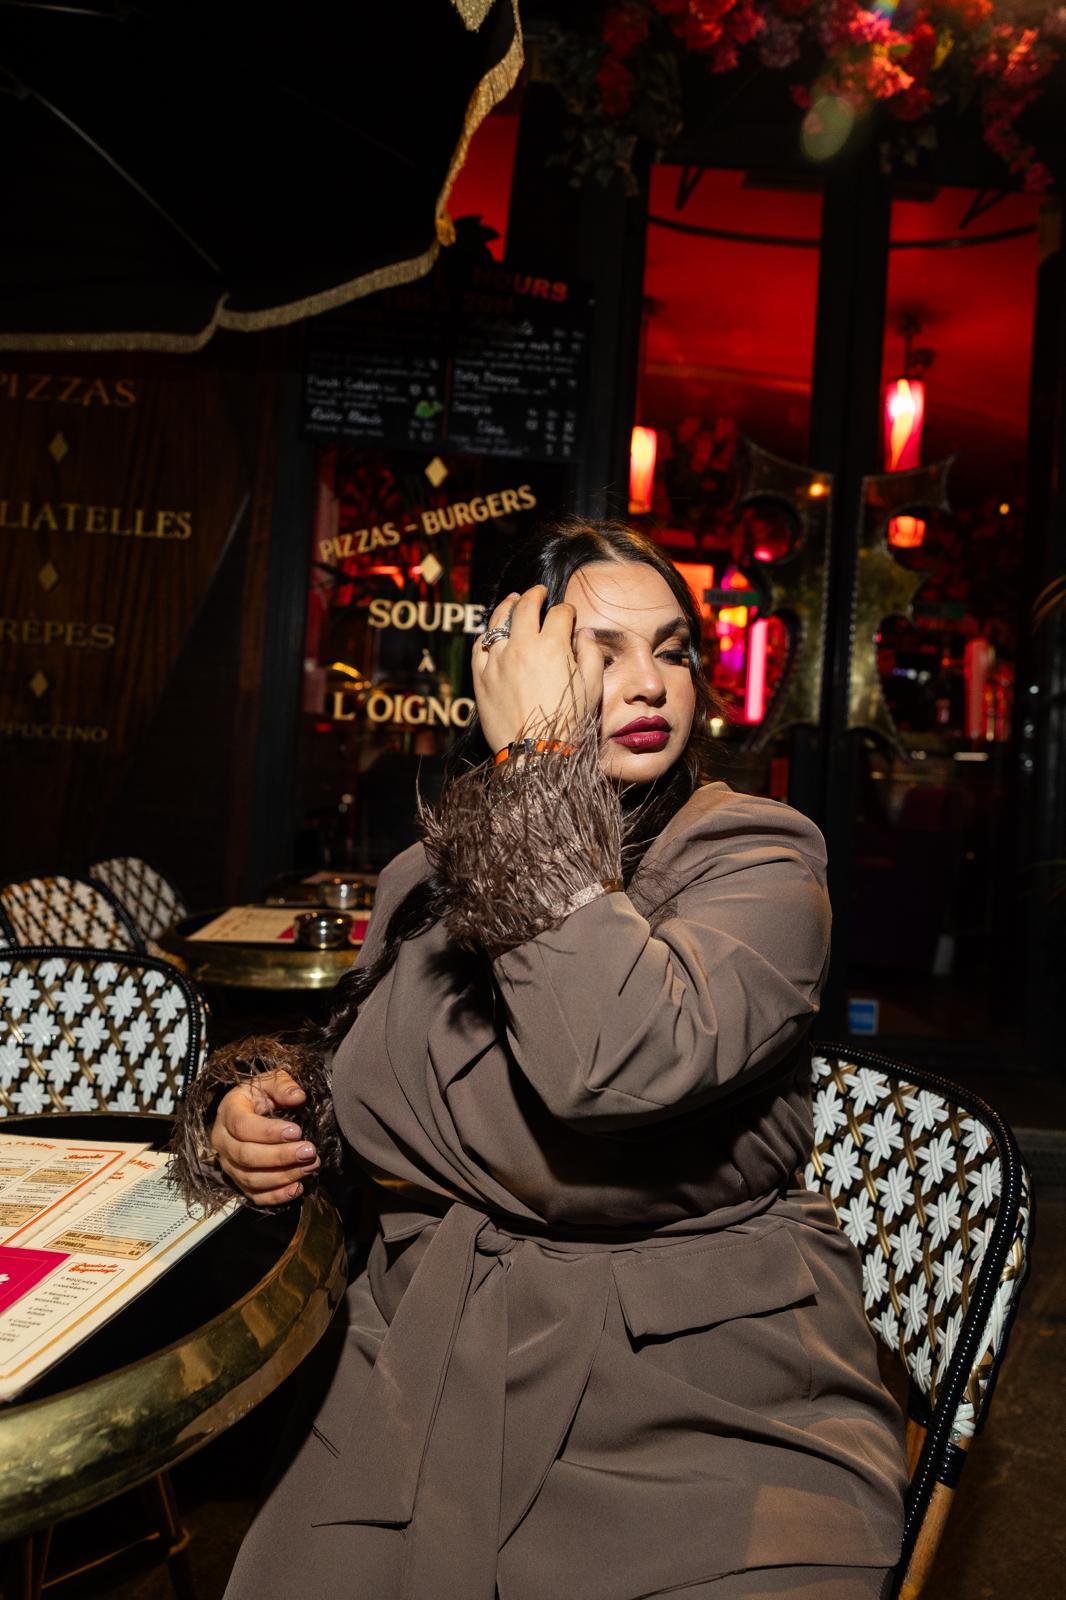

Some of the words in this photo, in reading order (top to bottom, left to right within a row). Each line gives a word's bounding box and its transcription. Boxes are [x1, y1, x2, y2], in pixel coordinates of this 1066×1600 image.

[320, 522, 401, 563] PIZZAS
[421, 484, 537, 535] BURGERS
[367, 598, 487, 634] SOUPE
